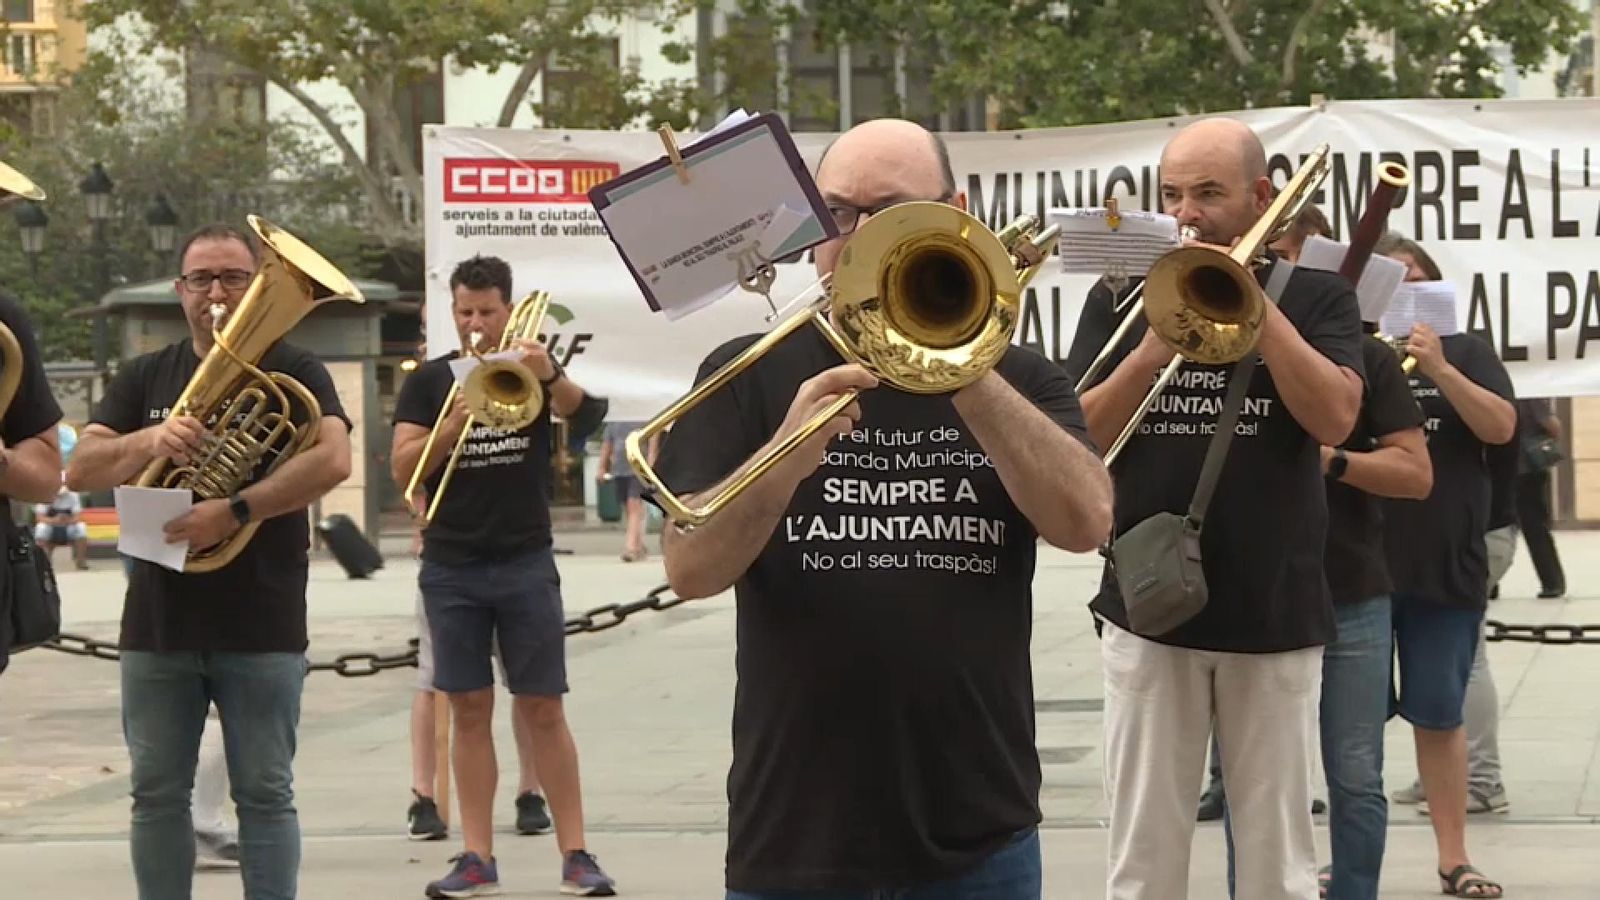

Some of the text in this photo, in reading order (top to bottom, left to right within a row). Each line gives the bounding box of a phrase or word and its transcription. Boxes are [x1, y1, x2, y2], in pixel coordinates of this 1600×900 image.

[451, 167, 565, 194] CCOO
[1498, 148, 1534, 239] A
[442, 207, 599, 221] serveis a la ciutada
[455, 222, 609, 238] ajuntament de valènc
[1466, 272, 1528, 361] AL
[875, 427, 924, 446] futur
[929, 425, 960, 442] de
[1169, 422, 1196, 435] seu
[1200, 420, 1258, 436] traàs!
[822, 477, 979, 506] SEMPRE A
[802, 549, 997, 575] No al seu traspàs!
